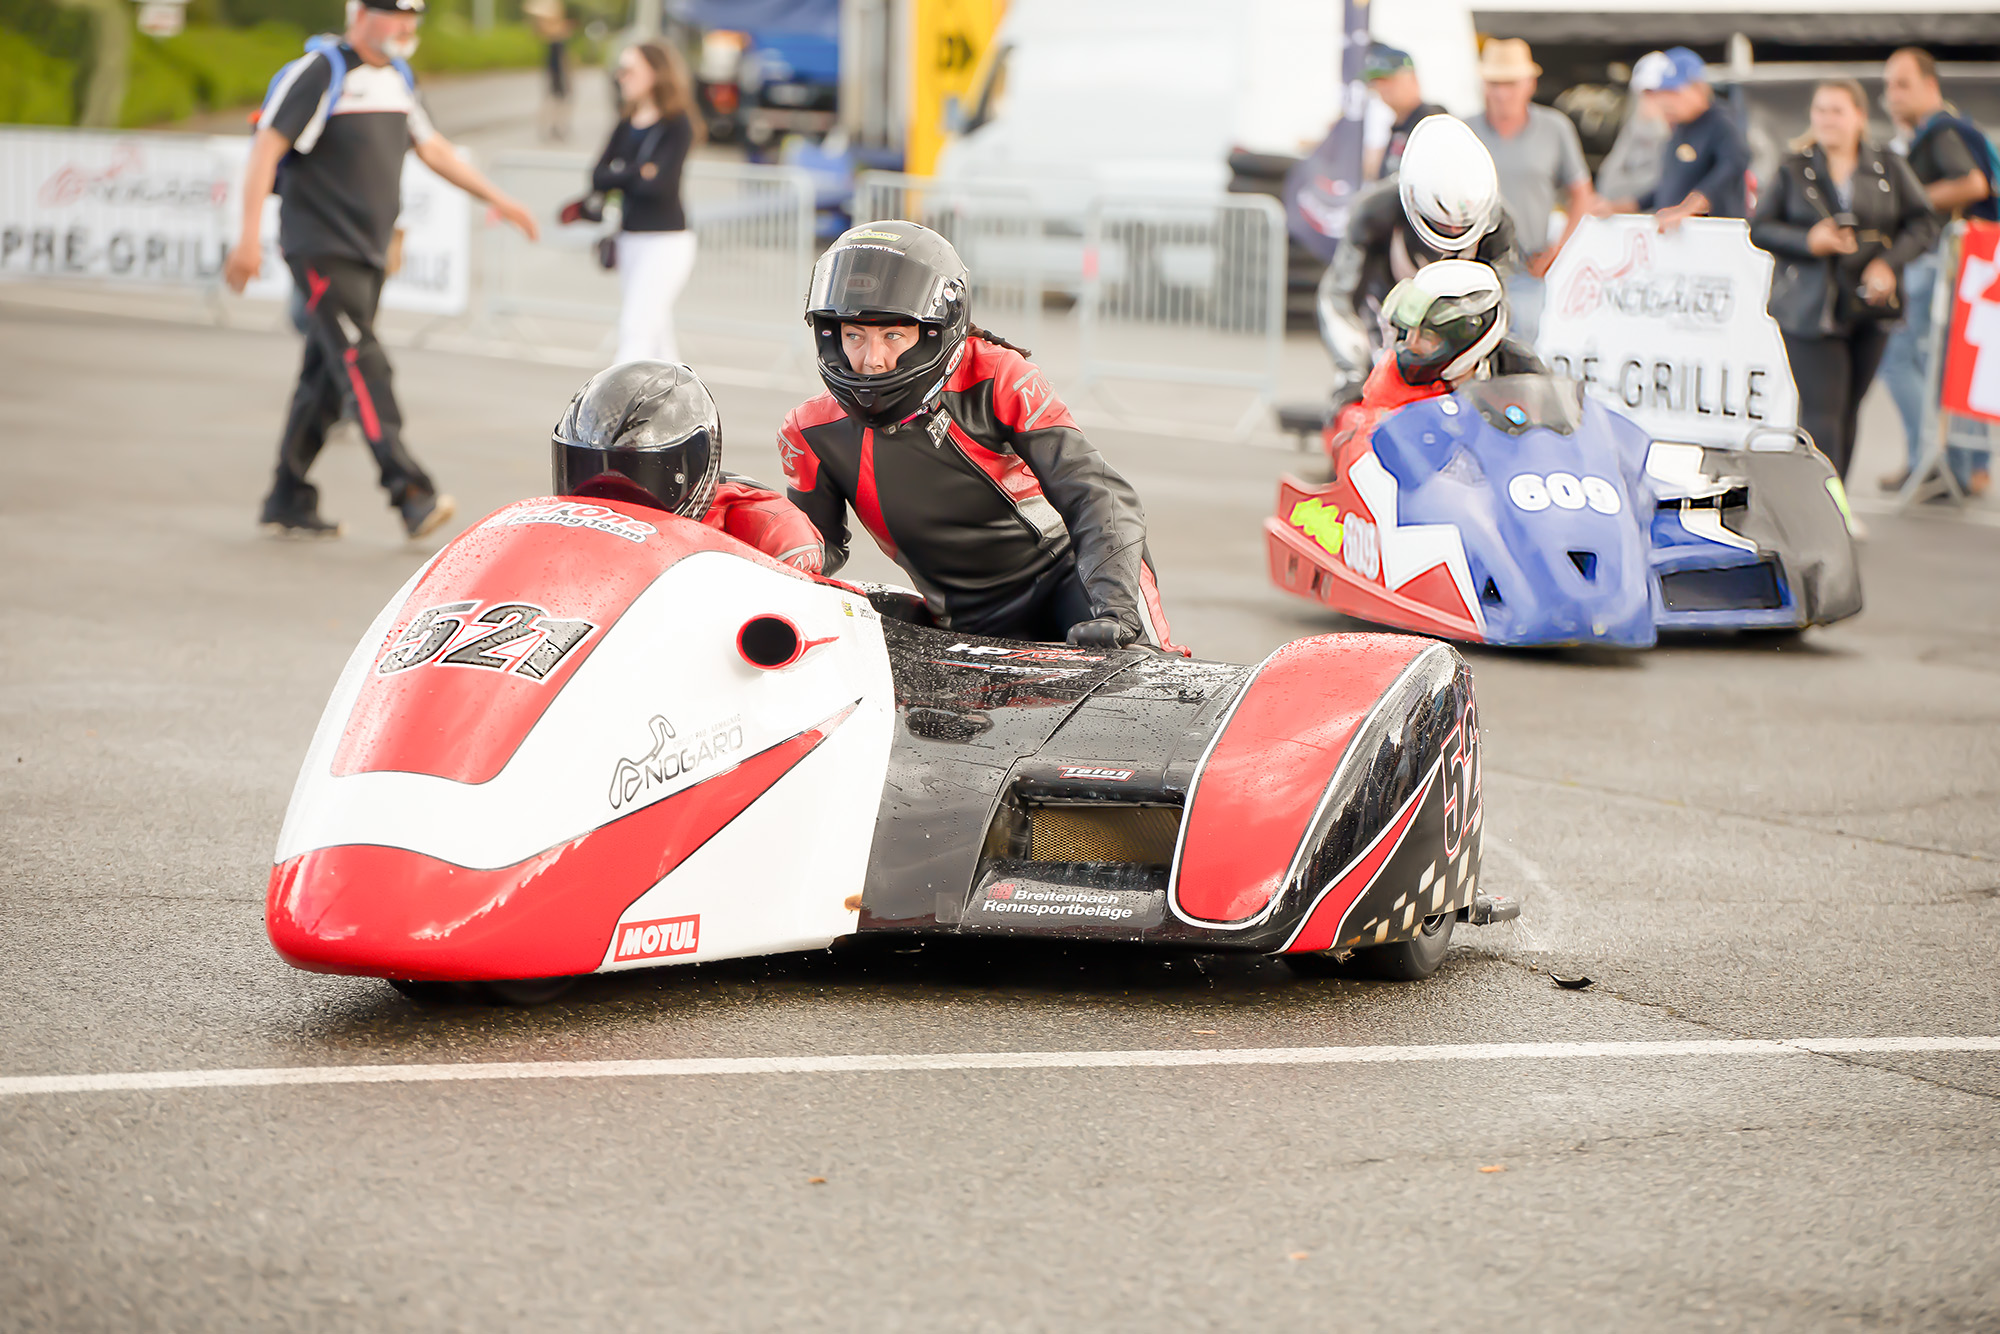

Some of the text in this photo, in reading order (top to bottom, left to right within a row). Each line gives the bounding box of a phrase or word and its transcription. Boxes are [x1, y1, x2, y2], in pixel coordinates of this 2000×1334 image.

[949, 348, 962, 370] BELL
[1509, 473, 1621, 515] 609
[514, 514, 642, 541] Racing Team
[377, 600, 600, 684] 521
[644, 725, 743, 789] NOGARO
[1441, 700, 1481, 857] 52
[982, 899, 1133, 920] Rennsportbeläge
[1014, 890, 1120, 904] Breitenbach
[618, 920, 697, 957] MOTUL
